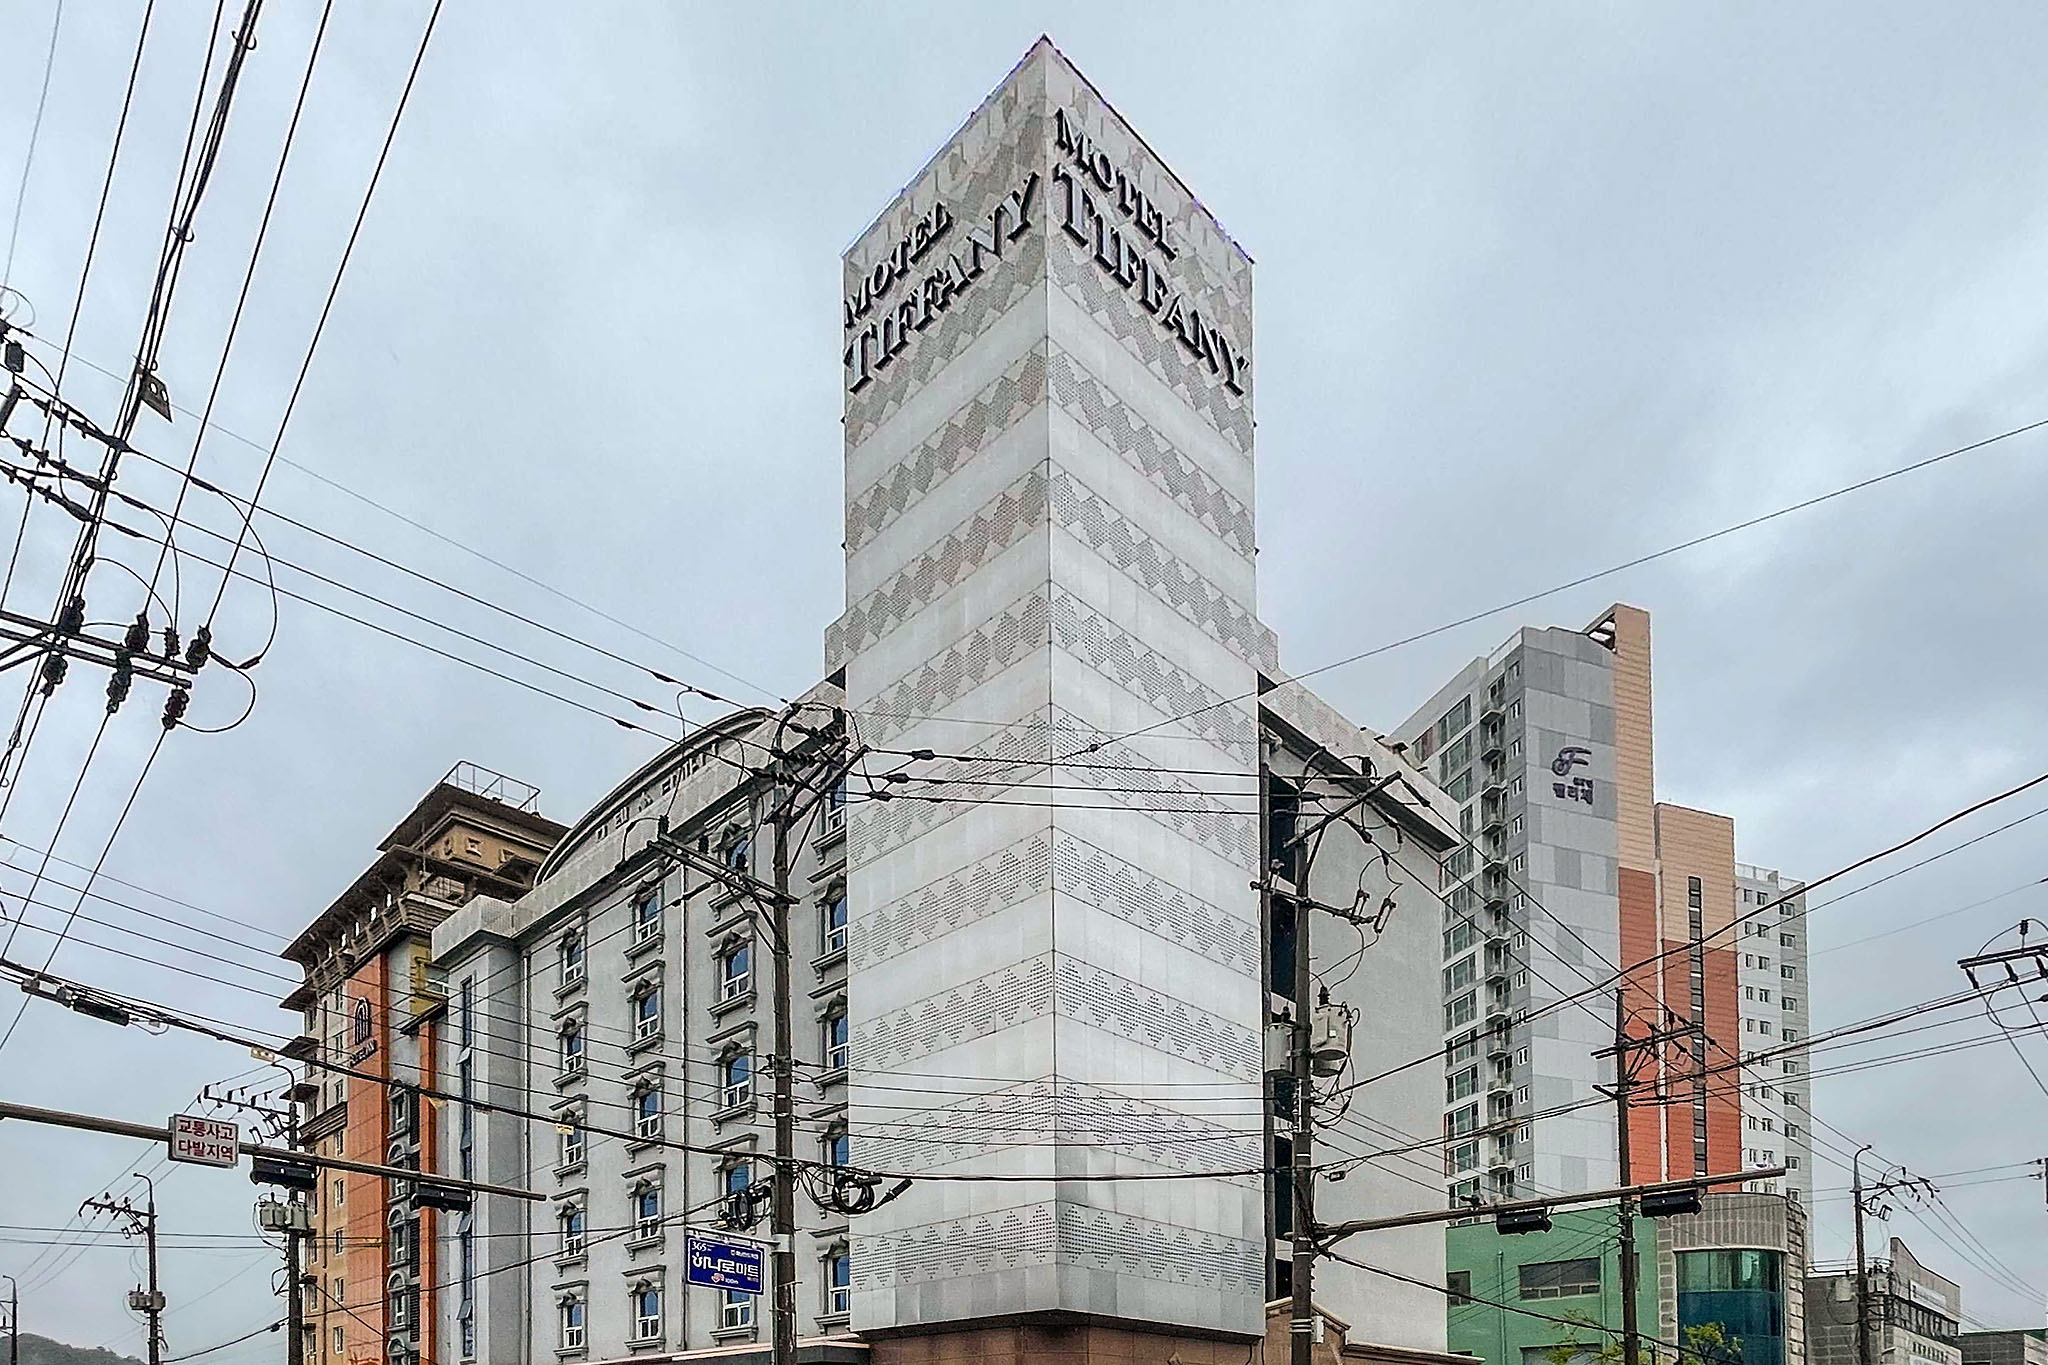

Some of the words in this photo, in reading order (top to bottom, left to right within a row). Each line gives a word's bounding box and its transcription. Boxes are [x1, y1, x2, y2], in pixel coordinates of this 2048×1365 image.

[1055, 107, 1178, 261] MOTEL
[843, 171, 1040, 394] TIFFANY
[844, 202, 954, 329] MOTEL
[1052, 163, 1250, 397] TIFFANY
[178, 1119, 234, 1140] 교통사고
[178, 1139, 234, 1161] 다발지역
[691, 1251, 759, 1278] 하나로마트
